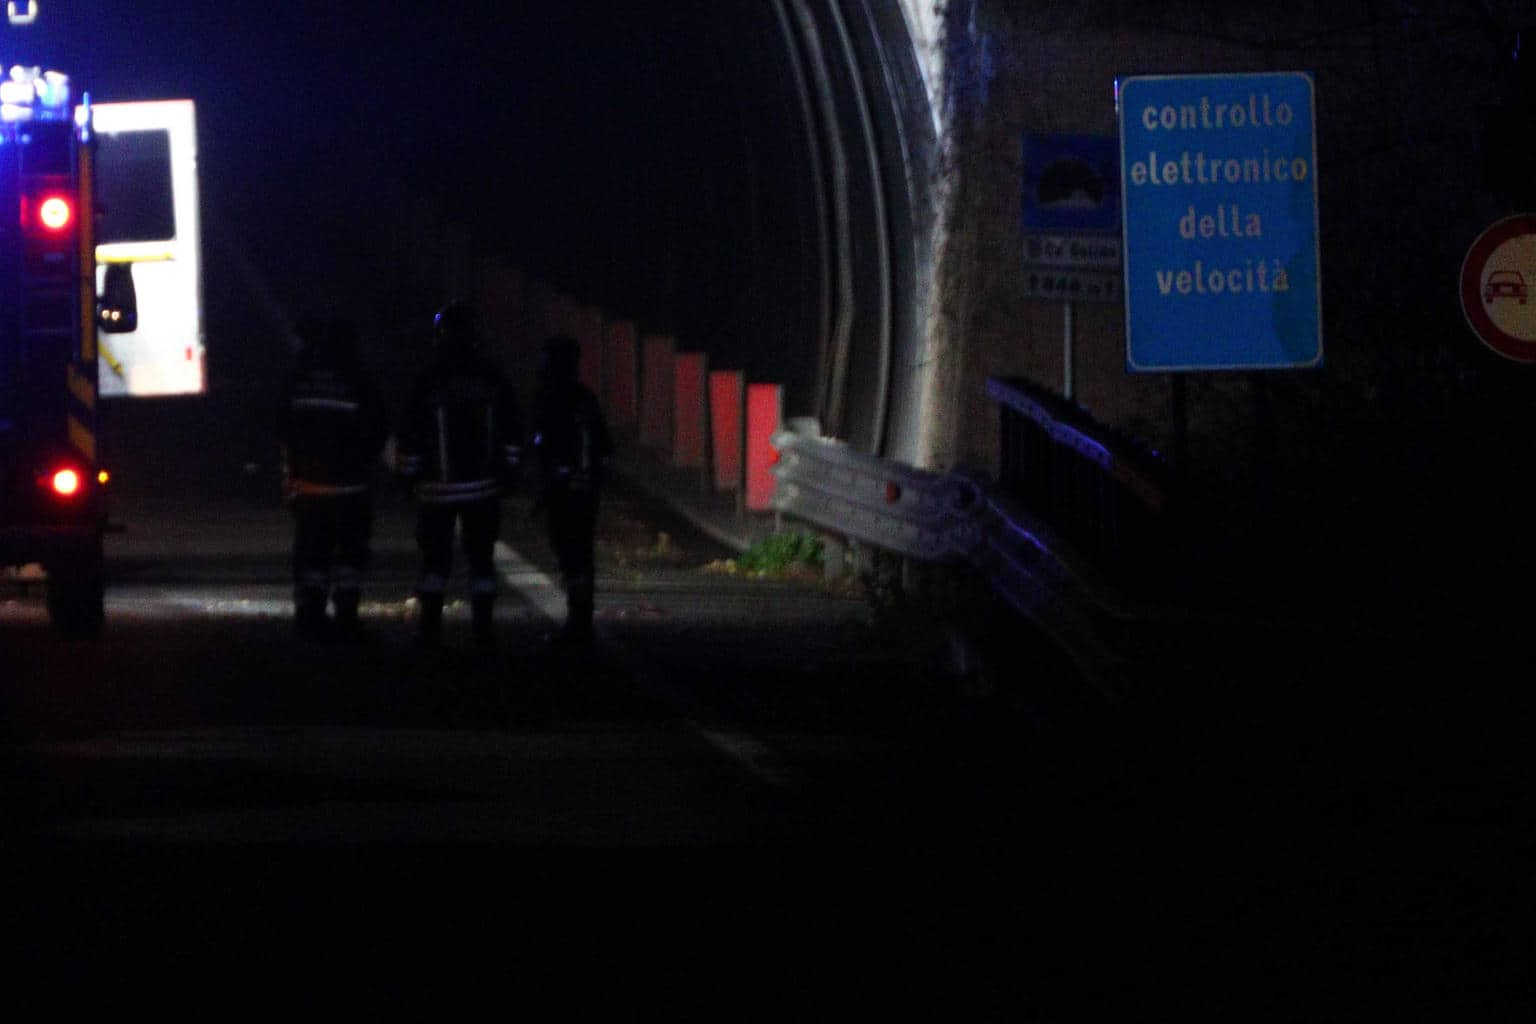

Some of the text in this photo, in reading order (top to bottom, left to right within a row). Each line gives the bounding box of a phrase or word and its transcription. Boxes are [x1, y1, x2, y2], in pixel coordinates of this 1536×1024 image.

[1141, 93, 1294, 130] controllo
[1130, 148, 1309, 185] elettronico
[1178, 203, 1263, 241] della
[1155, 258, 1290, 294] velocità
